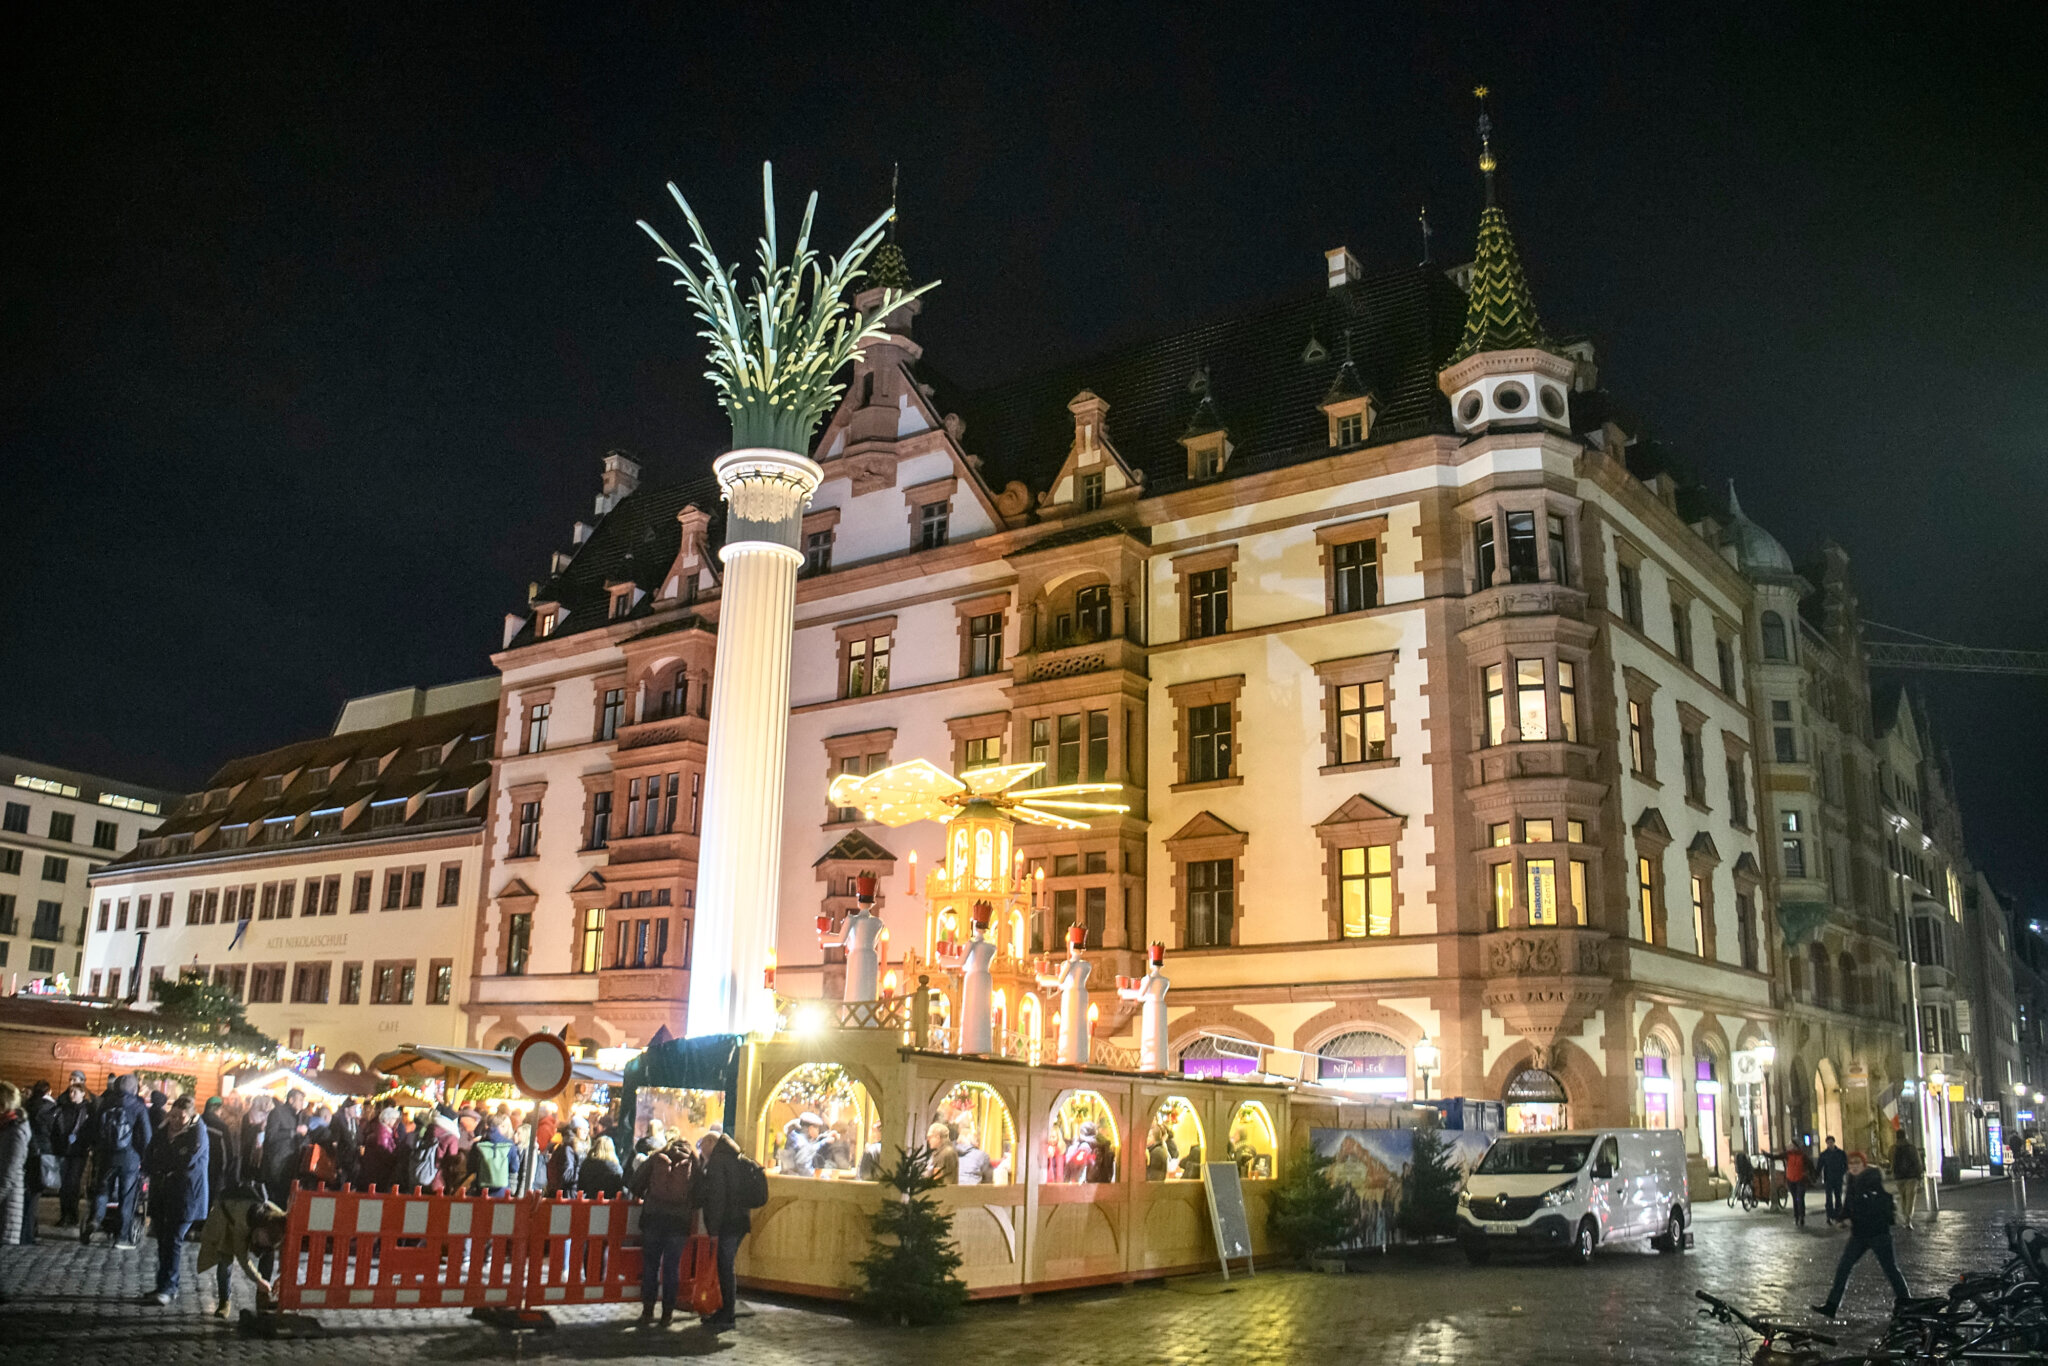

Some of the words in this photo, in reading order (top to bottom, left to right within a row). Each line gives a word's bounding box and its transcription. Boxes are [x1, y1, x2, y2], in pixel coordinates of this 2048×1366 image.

[1533, 877, 1541, 918] Diakonie
[266, 937, 284, 948] ALTE
[286, 933, 348, 948] NIKOLAISCHULE
